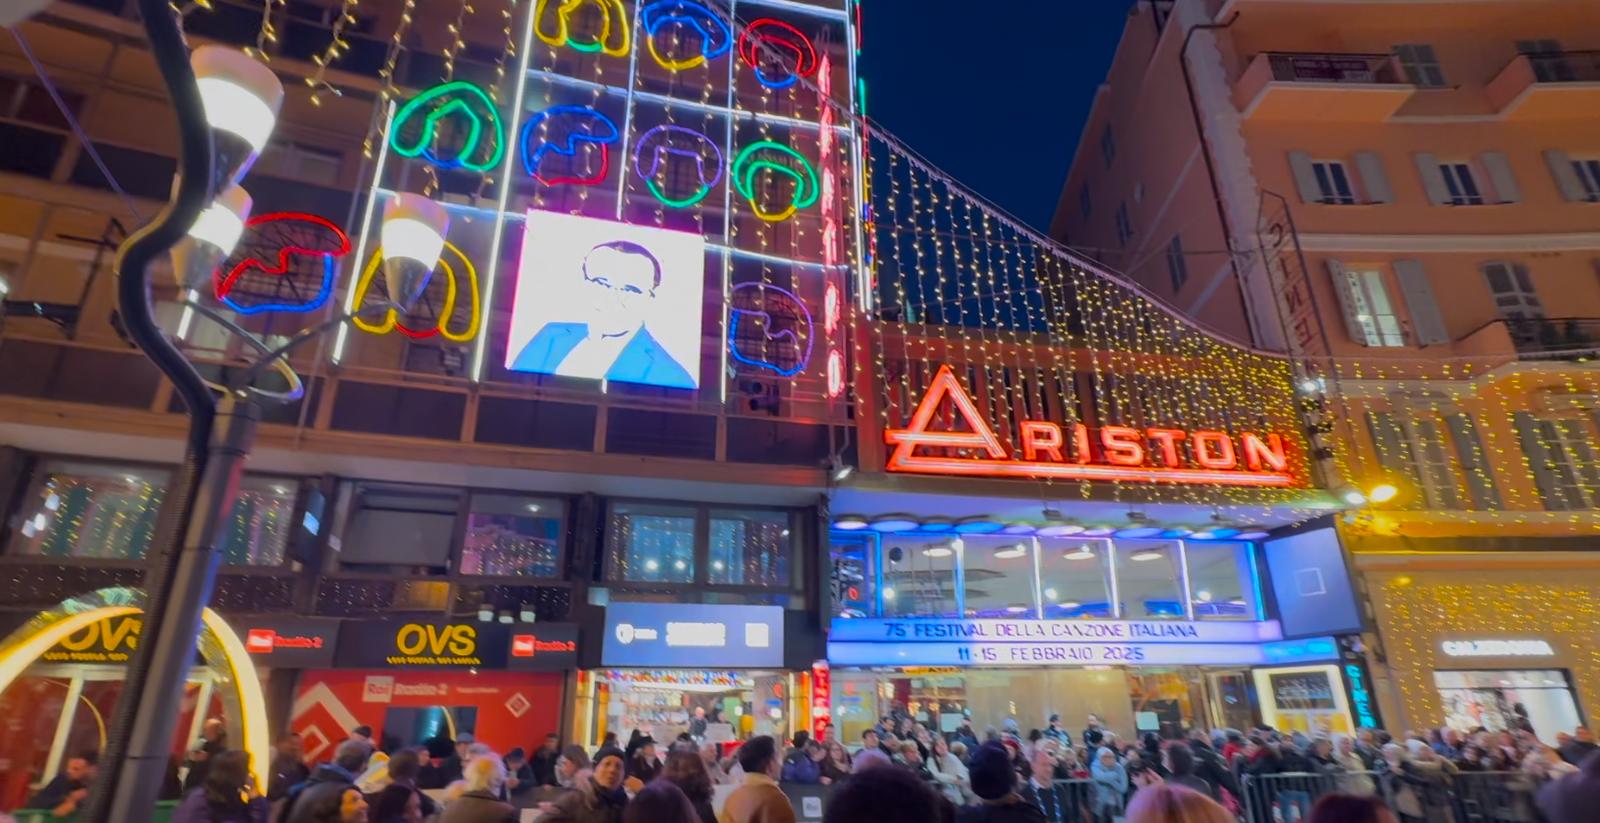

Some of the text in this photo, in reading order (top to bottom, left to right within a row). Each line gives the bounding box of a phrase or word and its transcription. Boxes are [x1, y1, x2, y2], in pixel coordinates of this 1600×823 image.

[914, 623, 989, 637] FESTIVAL
[995, 623, 1046, 637] DELLA
[1051, 623, 1124, 637] CANZONE
[1128, 623, 1199, 638] ITALIANA
[396, 623, 477, 656] OVS
[1010, 647, 1092, 660] FEBBRAIO
[1103, 647, 1144, 660] 2025
